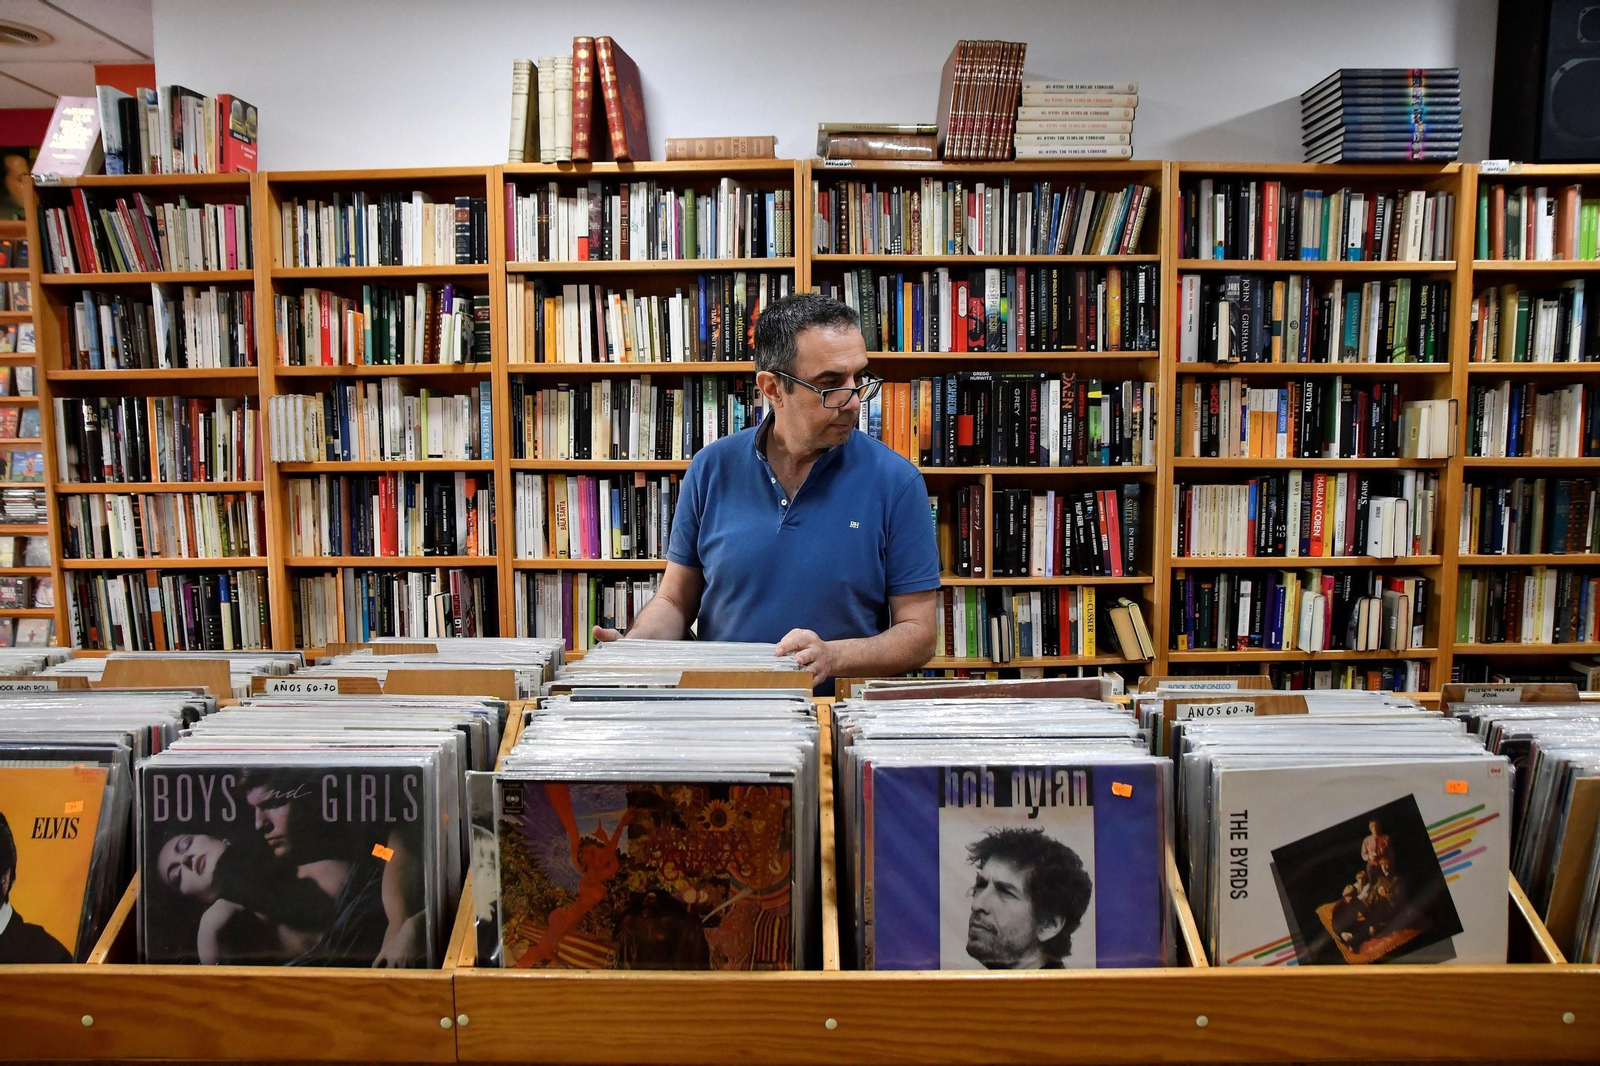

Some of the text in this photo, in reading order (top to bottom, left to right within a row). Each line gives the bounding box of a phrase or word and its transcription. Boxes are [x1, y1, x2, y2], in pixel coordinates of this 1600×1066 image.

[1053, 269, 1057, 278] NO
[737, 317, 745, 341] maya
[1302, 506, 1310, 538] PATTERSON
[274, 680, 301, 692] AÑOS
[1226, 705, 1254, 715] 60-70
[153, 774, 237, 822] BOYS
[322, 774, 418, 822] GIRLS
[1012, 766, 1088, 819] dylan
[31, 817, 79, 840] ELVIS
[1230, 809, 1248, 899] THE BYRDS
